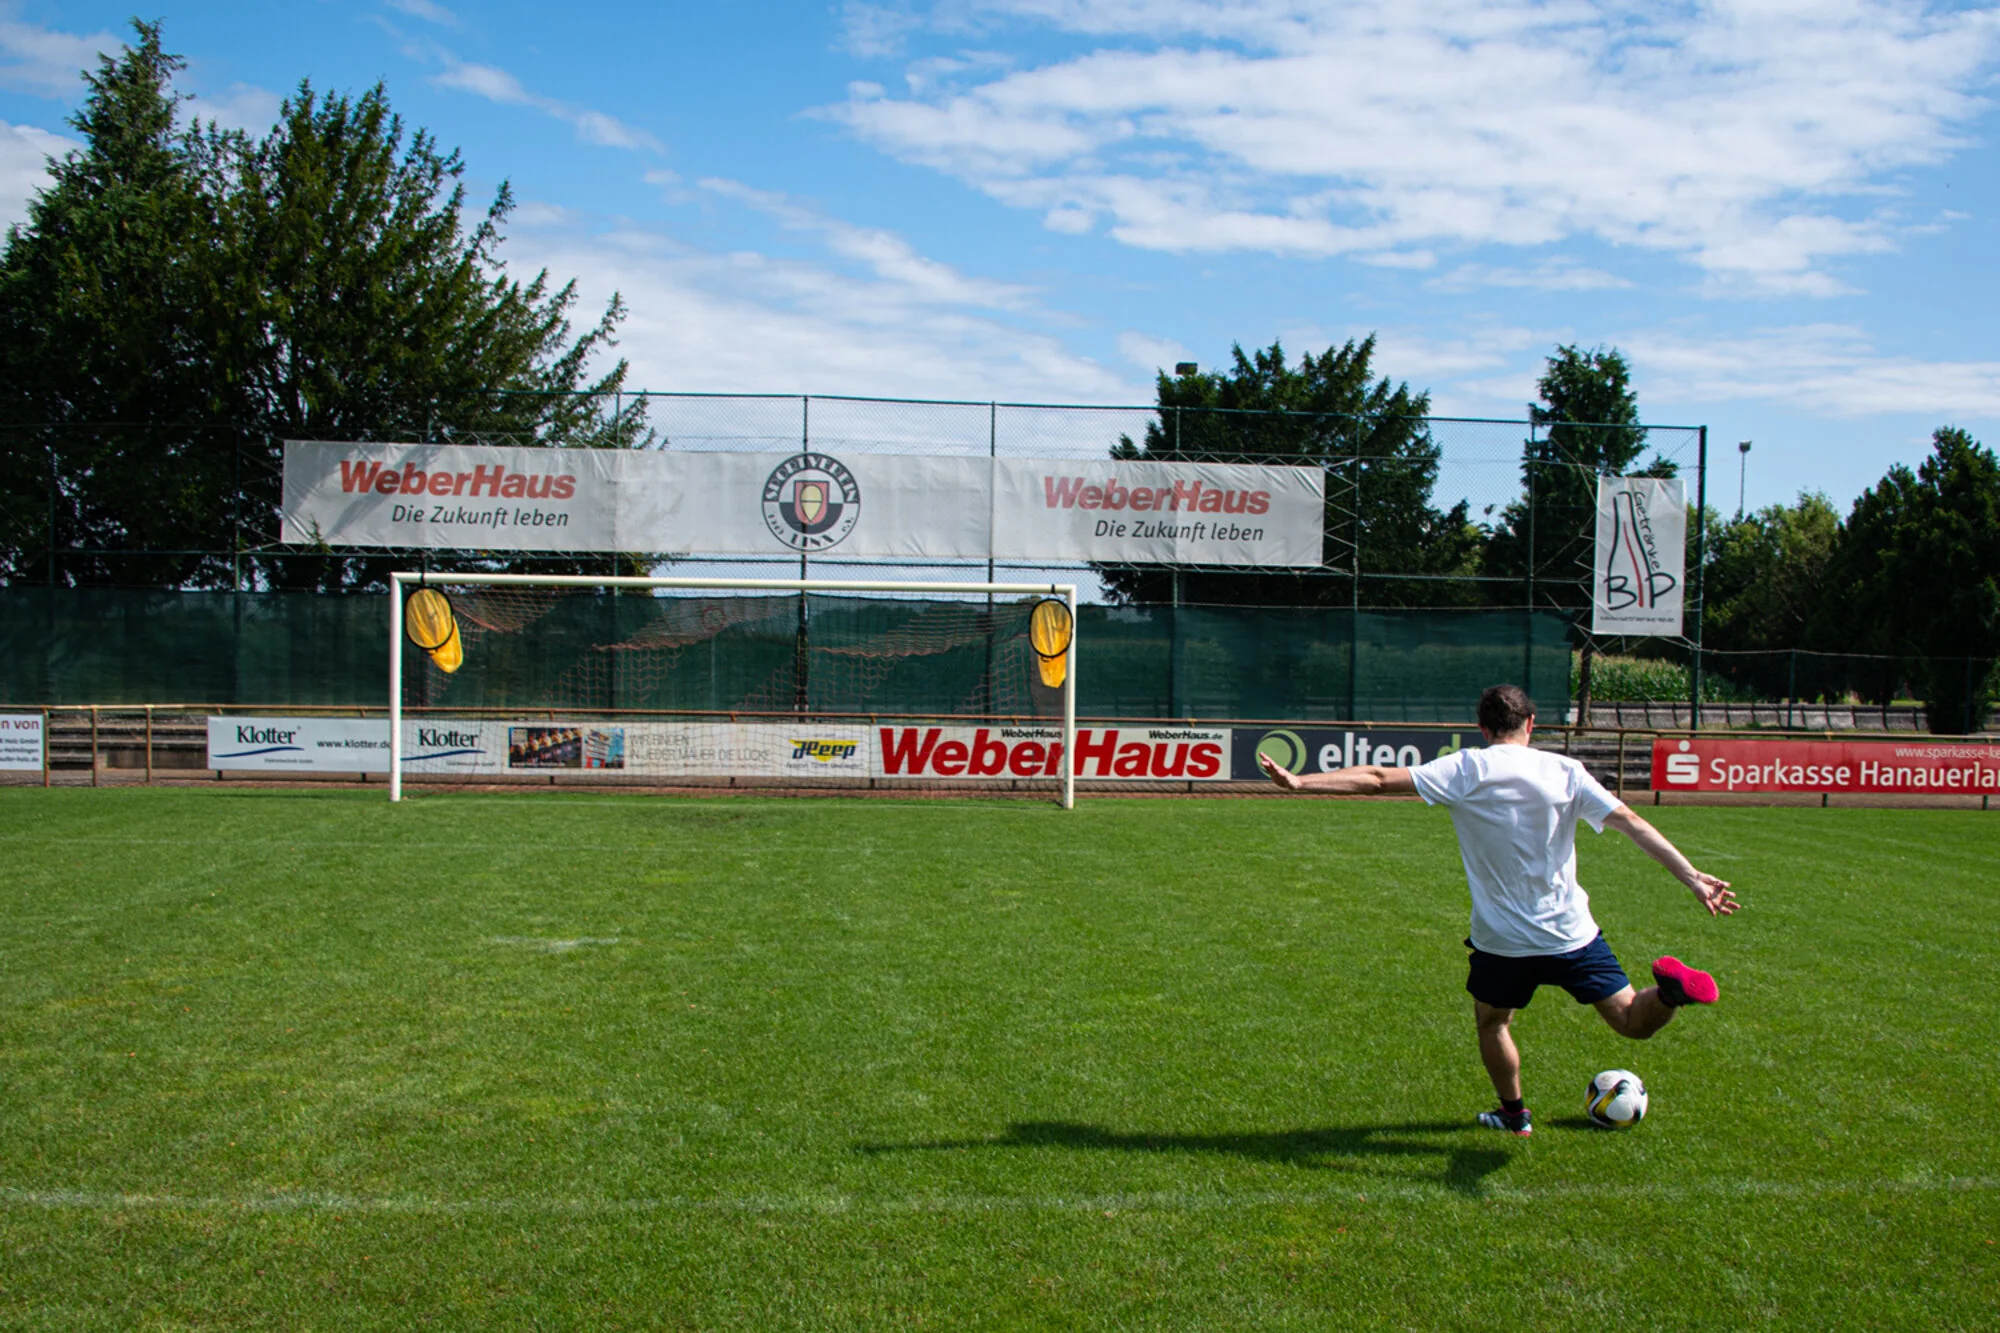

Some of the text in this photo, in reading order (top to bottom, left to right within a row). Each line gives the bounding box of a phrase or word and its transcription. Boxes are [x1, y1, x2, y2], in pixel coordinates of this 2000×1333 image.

[340, 460, 576, 500] WeberHaus
[1044, 476, 1271, 515] WeberHaus
[392, 504, 569, 528] Die Zukunft leben
[1095, 519, 1264, 544] Die Zukunft leben
[1633, 491, 1661, 573] Getränke
[13, 719, 40, 730] von
[236, 725, 297, 745] Klotter
[1149, 729, 1223, 740] WeberHaus.de
[418, 728, 479, 747] Klotter
[879, 727, 1224, 778] WeberHaus
[1709, 757, 2000, 790] Sparkasse Hanauerla
